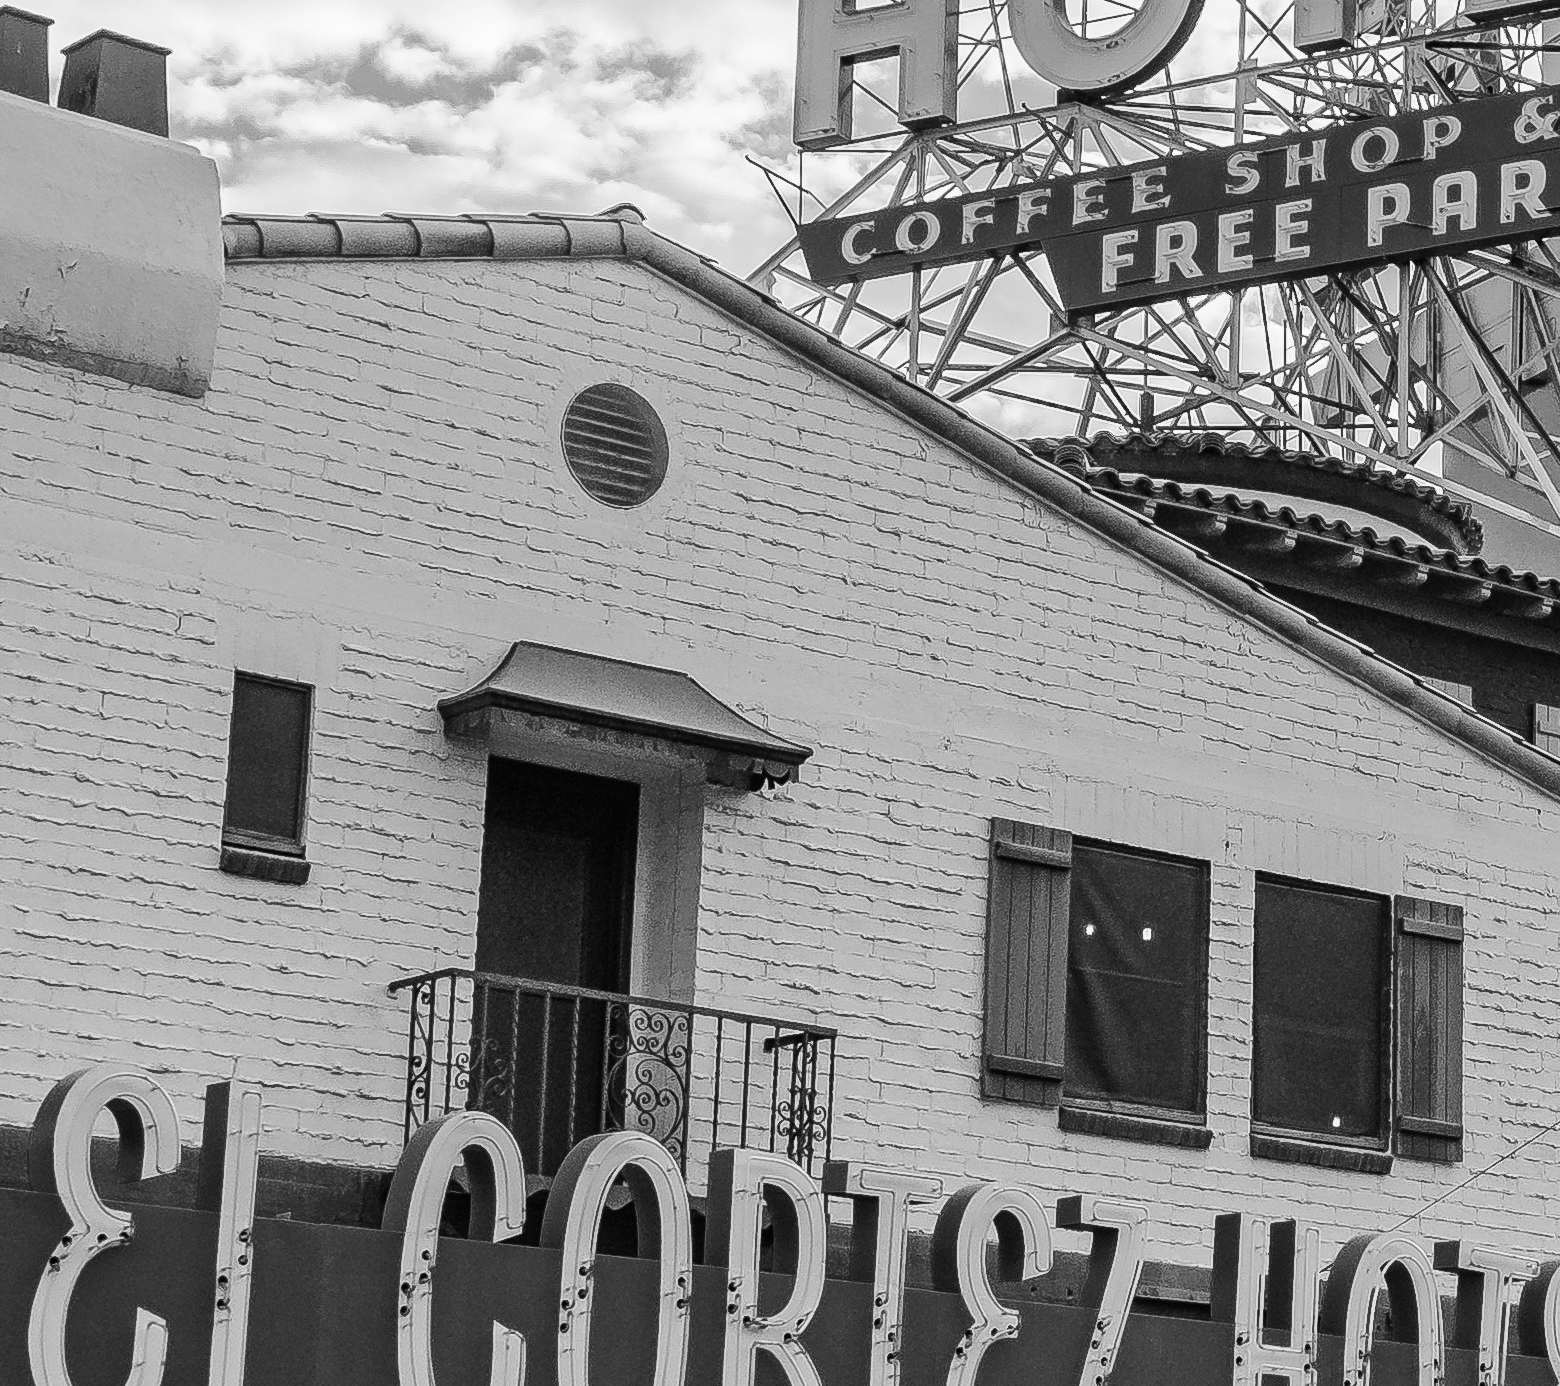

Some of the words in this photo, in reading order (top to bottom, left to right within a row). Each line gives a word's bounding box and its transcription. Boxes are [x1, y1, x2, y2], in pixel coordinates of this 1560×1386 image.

[841, 168, 1172, 268] COFFEE
[1225, 115, 1461, 196] SHOP
[1099, 196, 1314, 293] FREE
